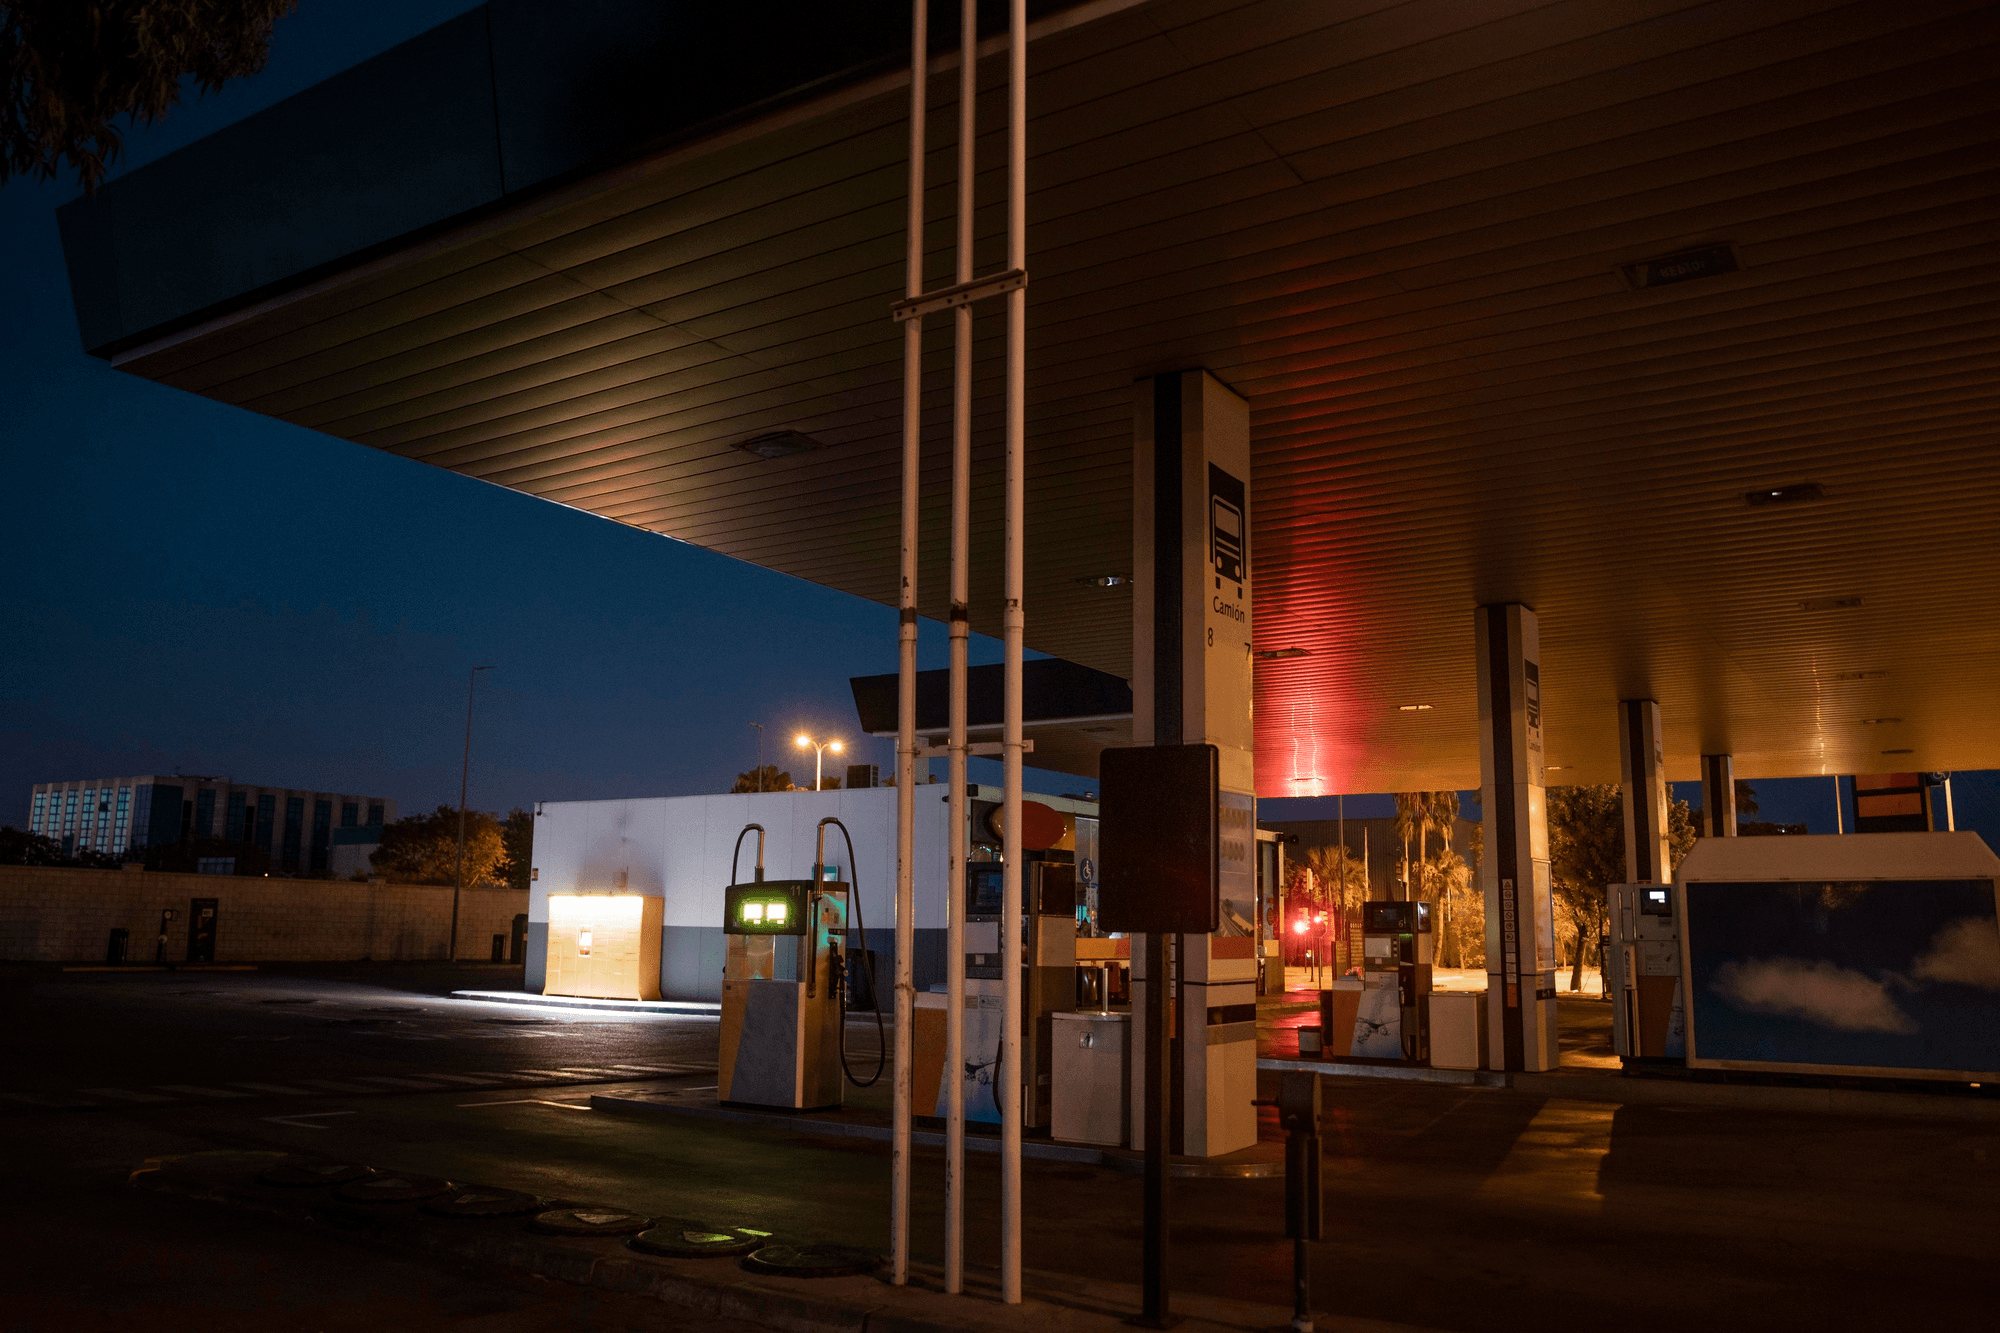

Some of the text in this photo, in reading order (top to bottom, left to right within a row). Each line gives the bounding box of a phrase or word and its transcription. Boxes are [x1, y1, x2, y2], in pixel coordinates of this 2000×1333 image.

[1213, 596, 1245, 623] Camión
[1208, 627, 1214, 648] 8
[1244, 642, 1251, 661] 7
[790, 885, 801, 896] 11
[1398, 919, 1404, 928] 6
